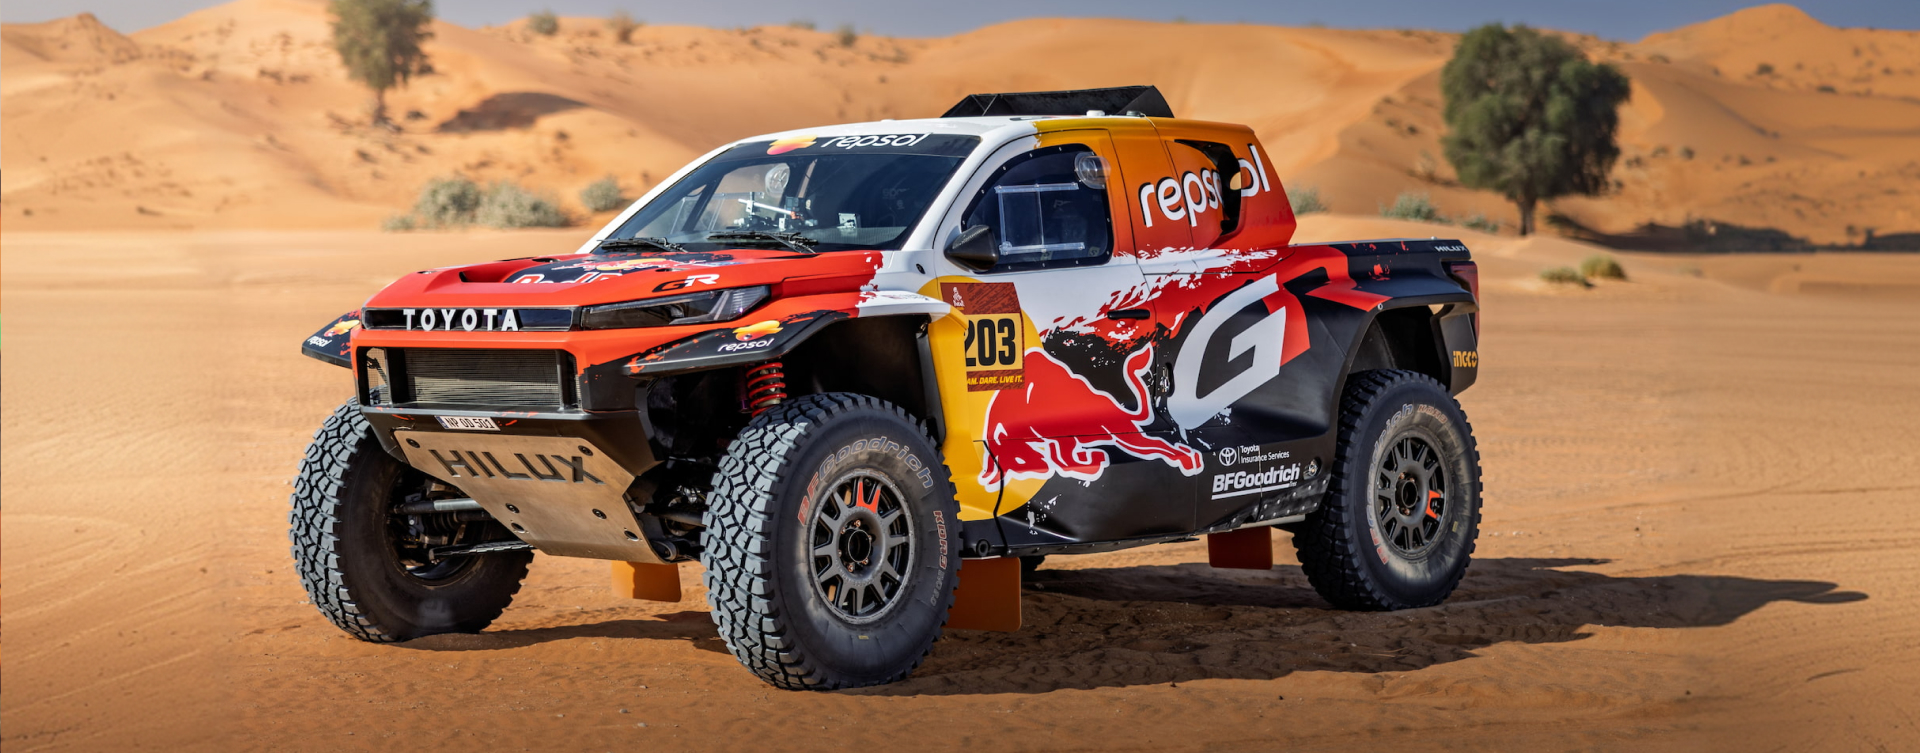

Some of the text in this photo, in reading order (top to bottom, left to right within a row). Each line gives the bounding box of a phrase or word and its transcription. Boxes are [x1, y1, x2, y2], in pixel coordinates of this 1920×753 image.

[820, 132, 933, 150] repsol
[652, 274, 720, 293] GR
[403, 308, 519, 331] TOYOTA
[717, 338, 775, 352] repsol
[964, 318, 1015, 367] 203
[472, 418, 495, 429] 501
[1240, 444, 1260, 454] Toyota
[1241, 451, 1289, 464] Insurance Services
[428, 449, 606, 485] HILUX
[797, 436, 934, 527] BFGoodrich
[1212, 464, 1300, 492] BFGoodrich
